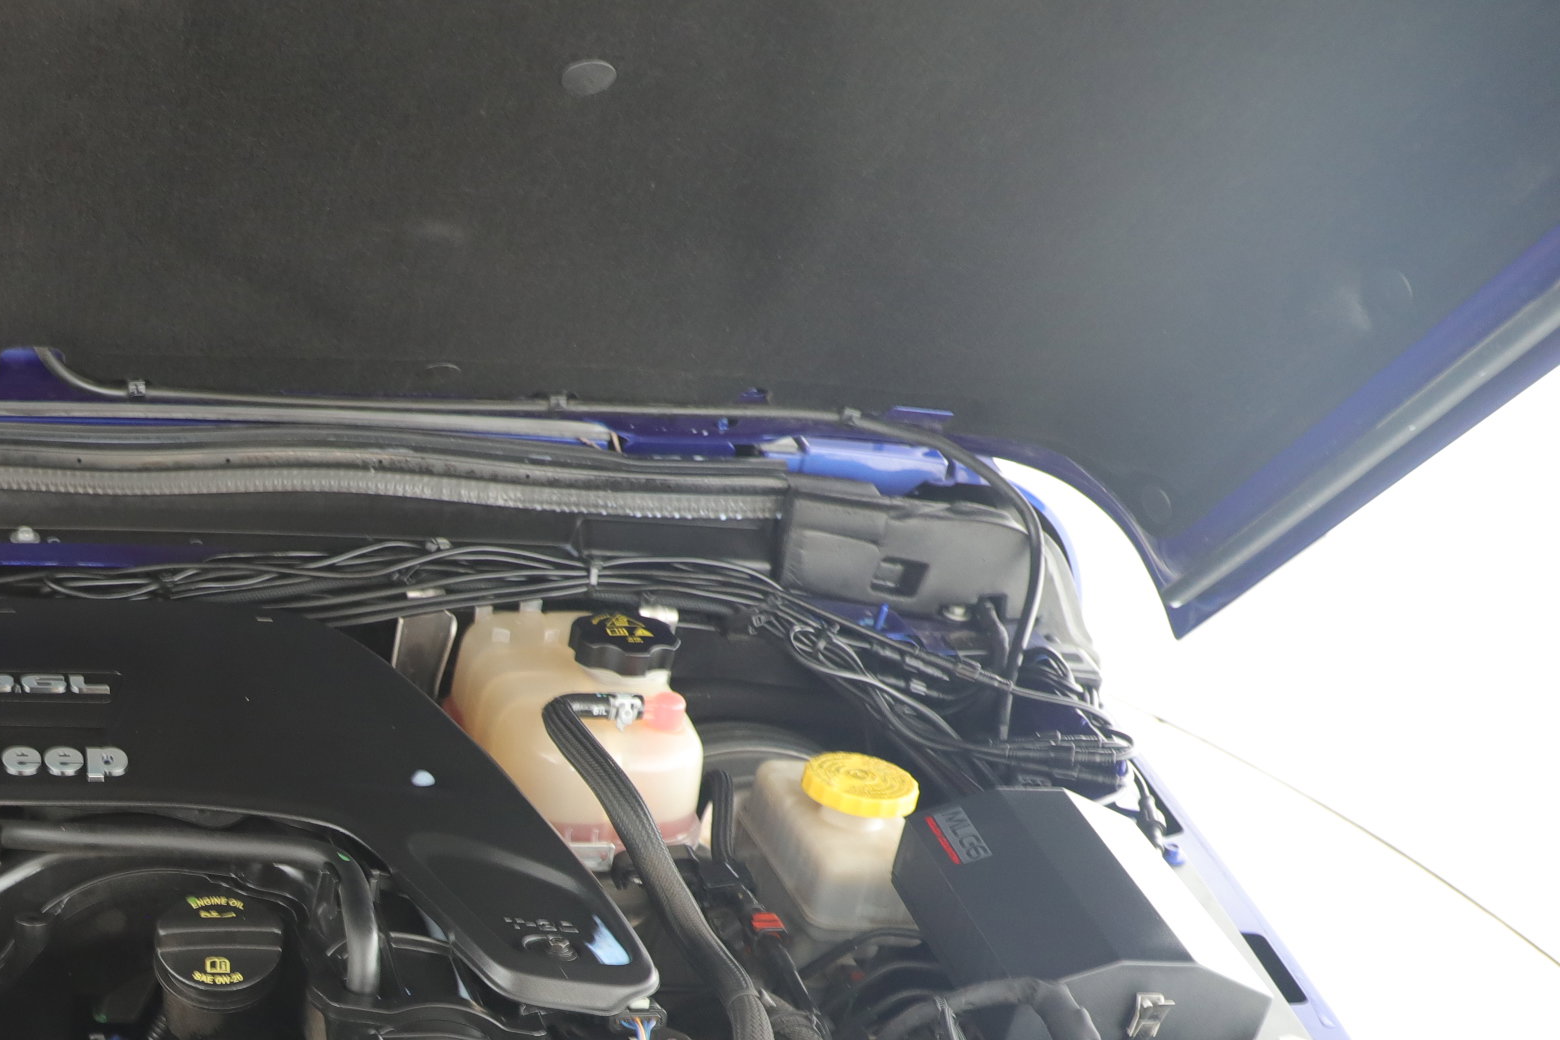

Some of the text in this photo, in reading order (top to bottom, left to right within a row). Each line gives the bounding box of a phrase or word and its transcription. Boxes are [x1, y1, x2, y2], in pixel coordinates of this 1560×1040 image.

[185, 896, 244, 910] ENGINE OIL
[192, 971, 244, 985] SAE 0W-20
